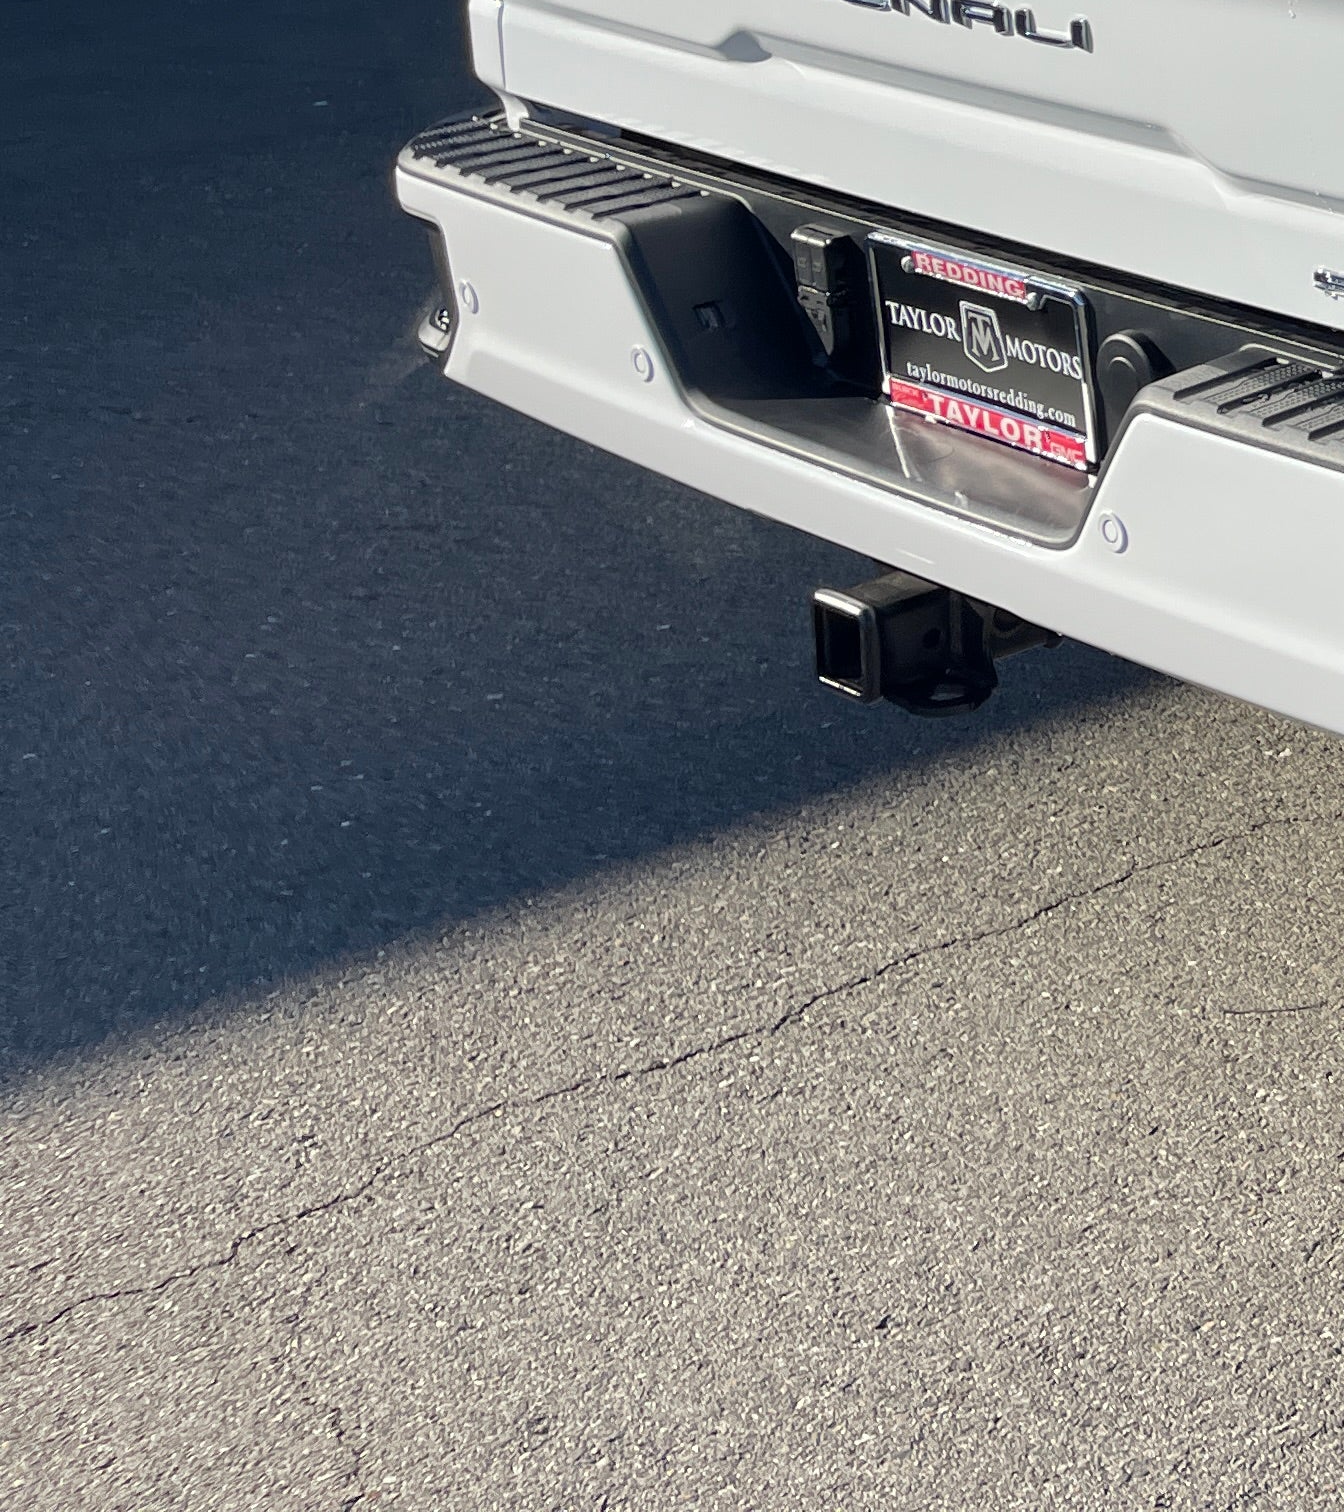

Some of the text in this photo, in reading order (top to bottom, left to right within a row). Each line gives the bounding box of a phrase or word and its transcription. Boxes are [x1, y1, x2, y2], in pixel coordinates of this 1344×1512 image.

[914, 252, 1025, 298] REDDING
[885, 300, 962, 342] TAYLOR
[1004, 334, 1082, 380] MOTORS
[906, 361, 1076, 428] taylormotorsredding.com
[926, 394, 1044, 451] TAYLOR
[1049, 442, 1084, 464] GMC
